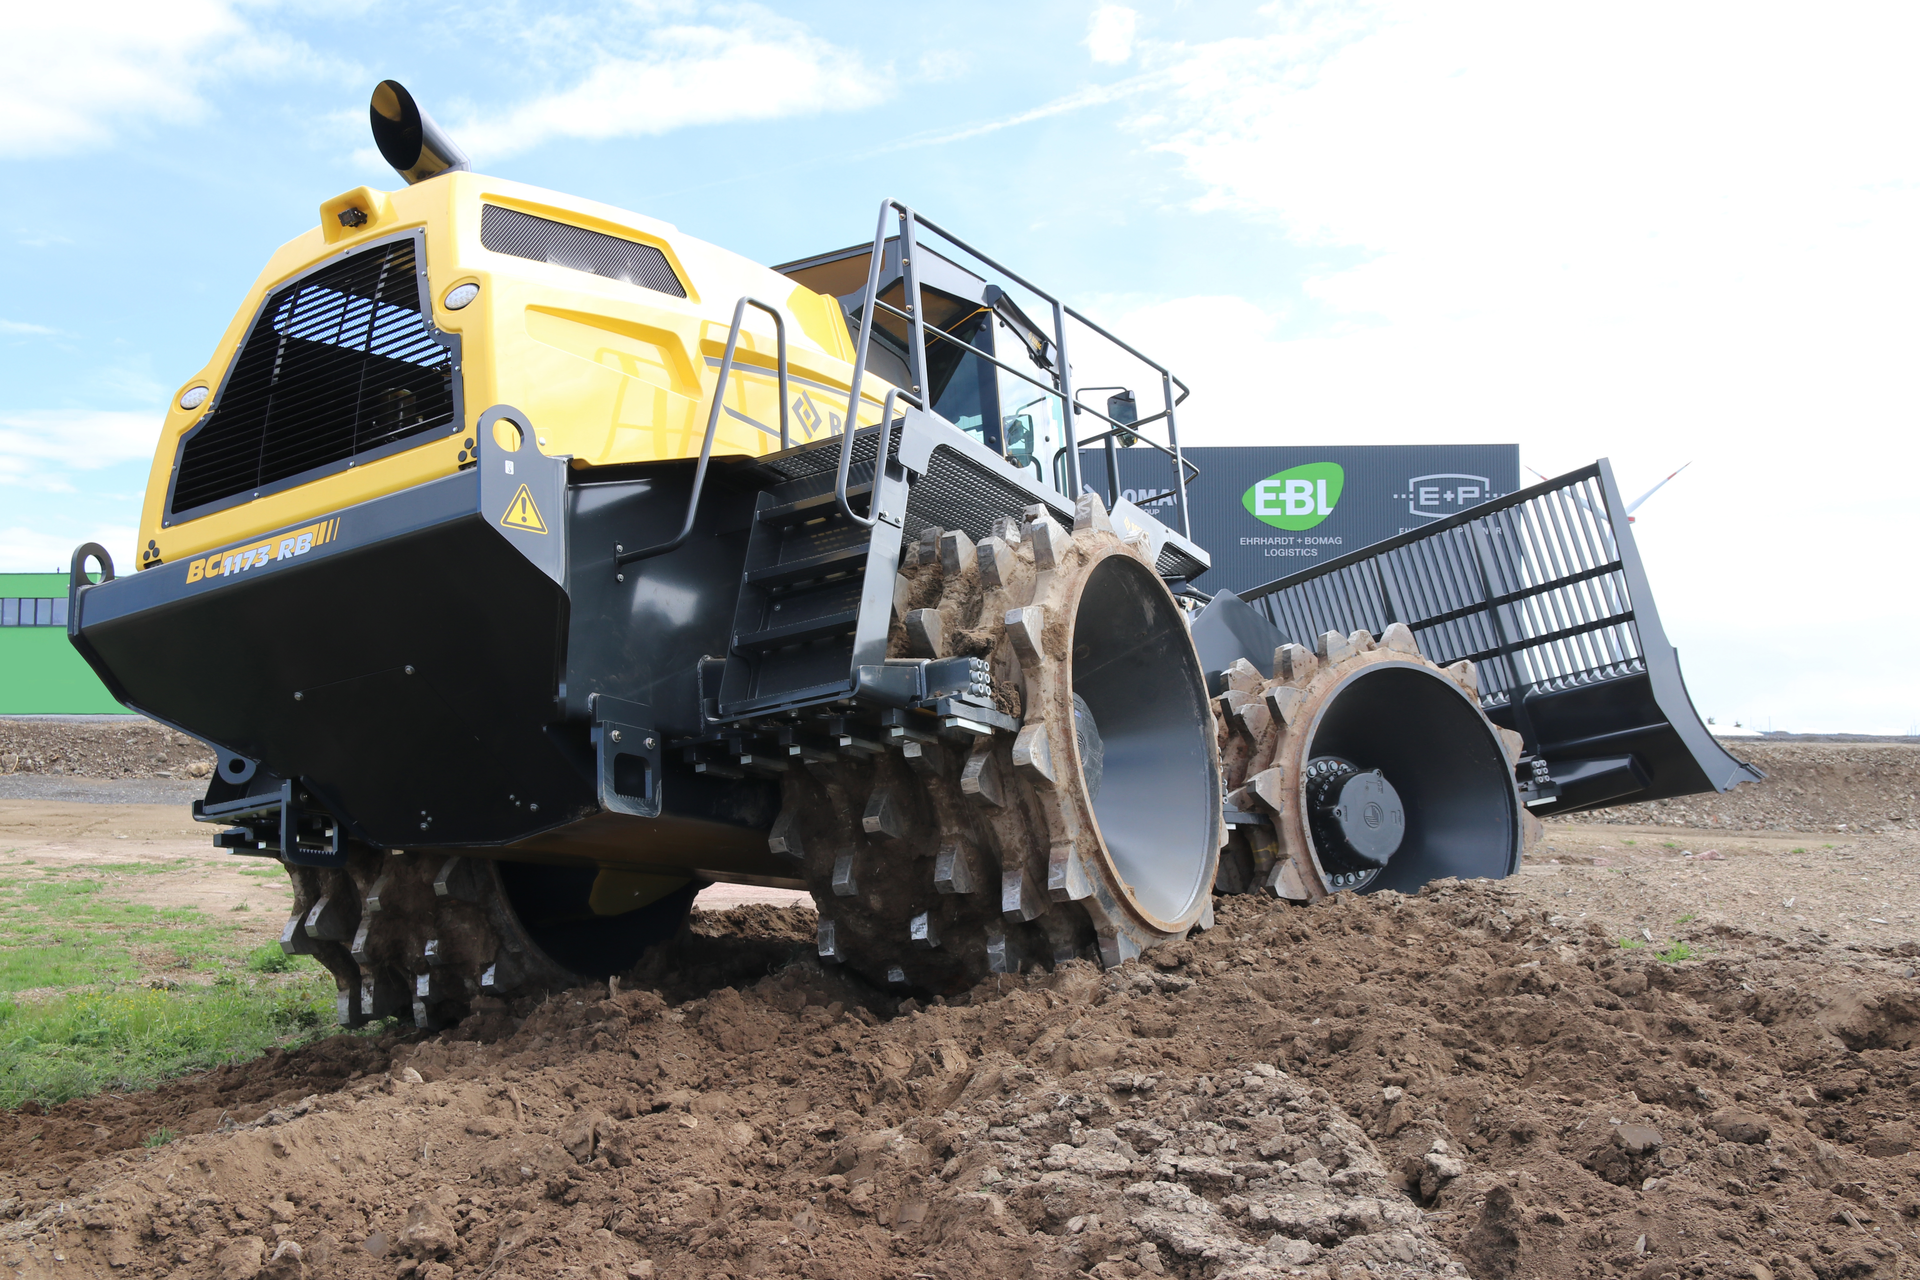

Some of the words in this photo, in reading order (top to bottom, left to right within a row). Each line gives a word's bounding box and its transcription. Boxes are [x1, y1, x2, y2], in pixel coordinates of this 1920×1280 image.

[1108, 488, 1188, 506] OMA
[1255, 479, 1333, 515] EBL
[276, 532, 313, 562] RB
[1240, 537, 1295, 546] EHRHARDT
[1304, 536, 1343, 545] BOMAG
[1264, 548, 1318, 557] LOGISTICS
